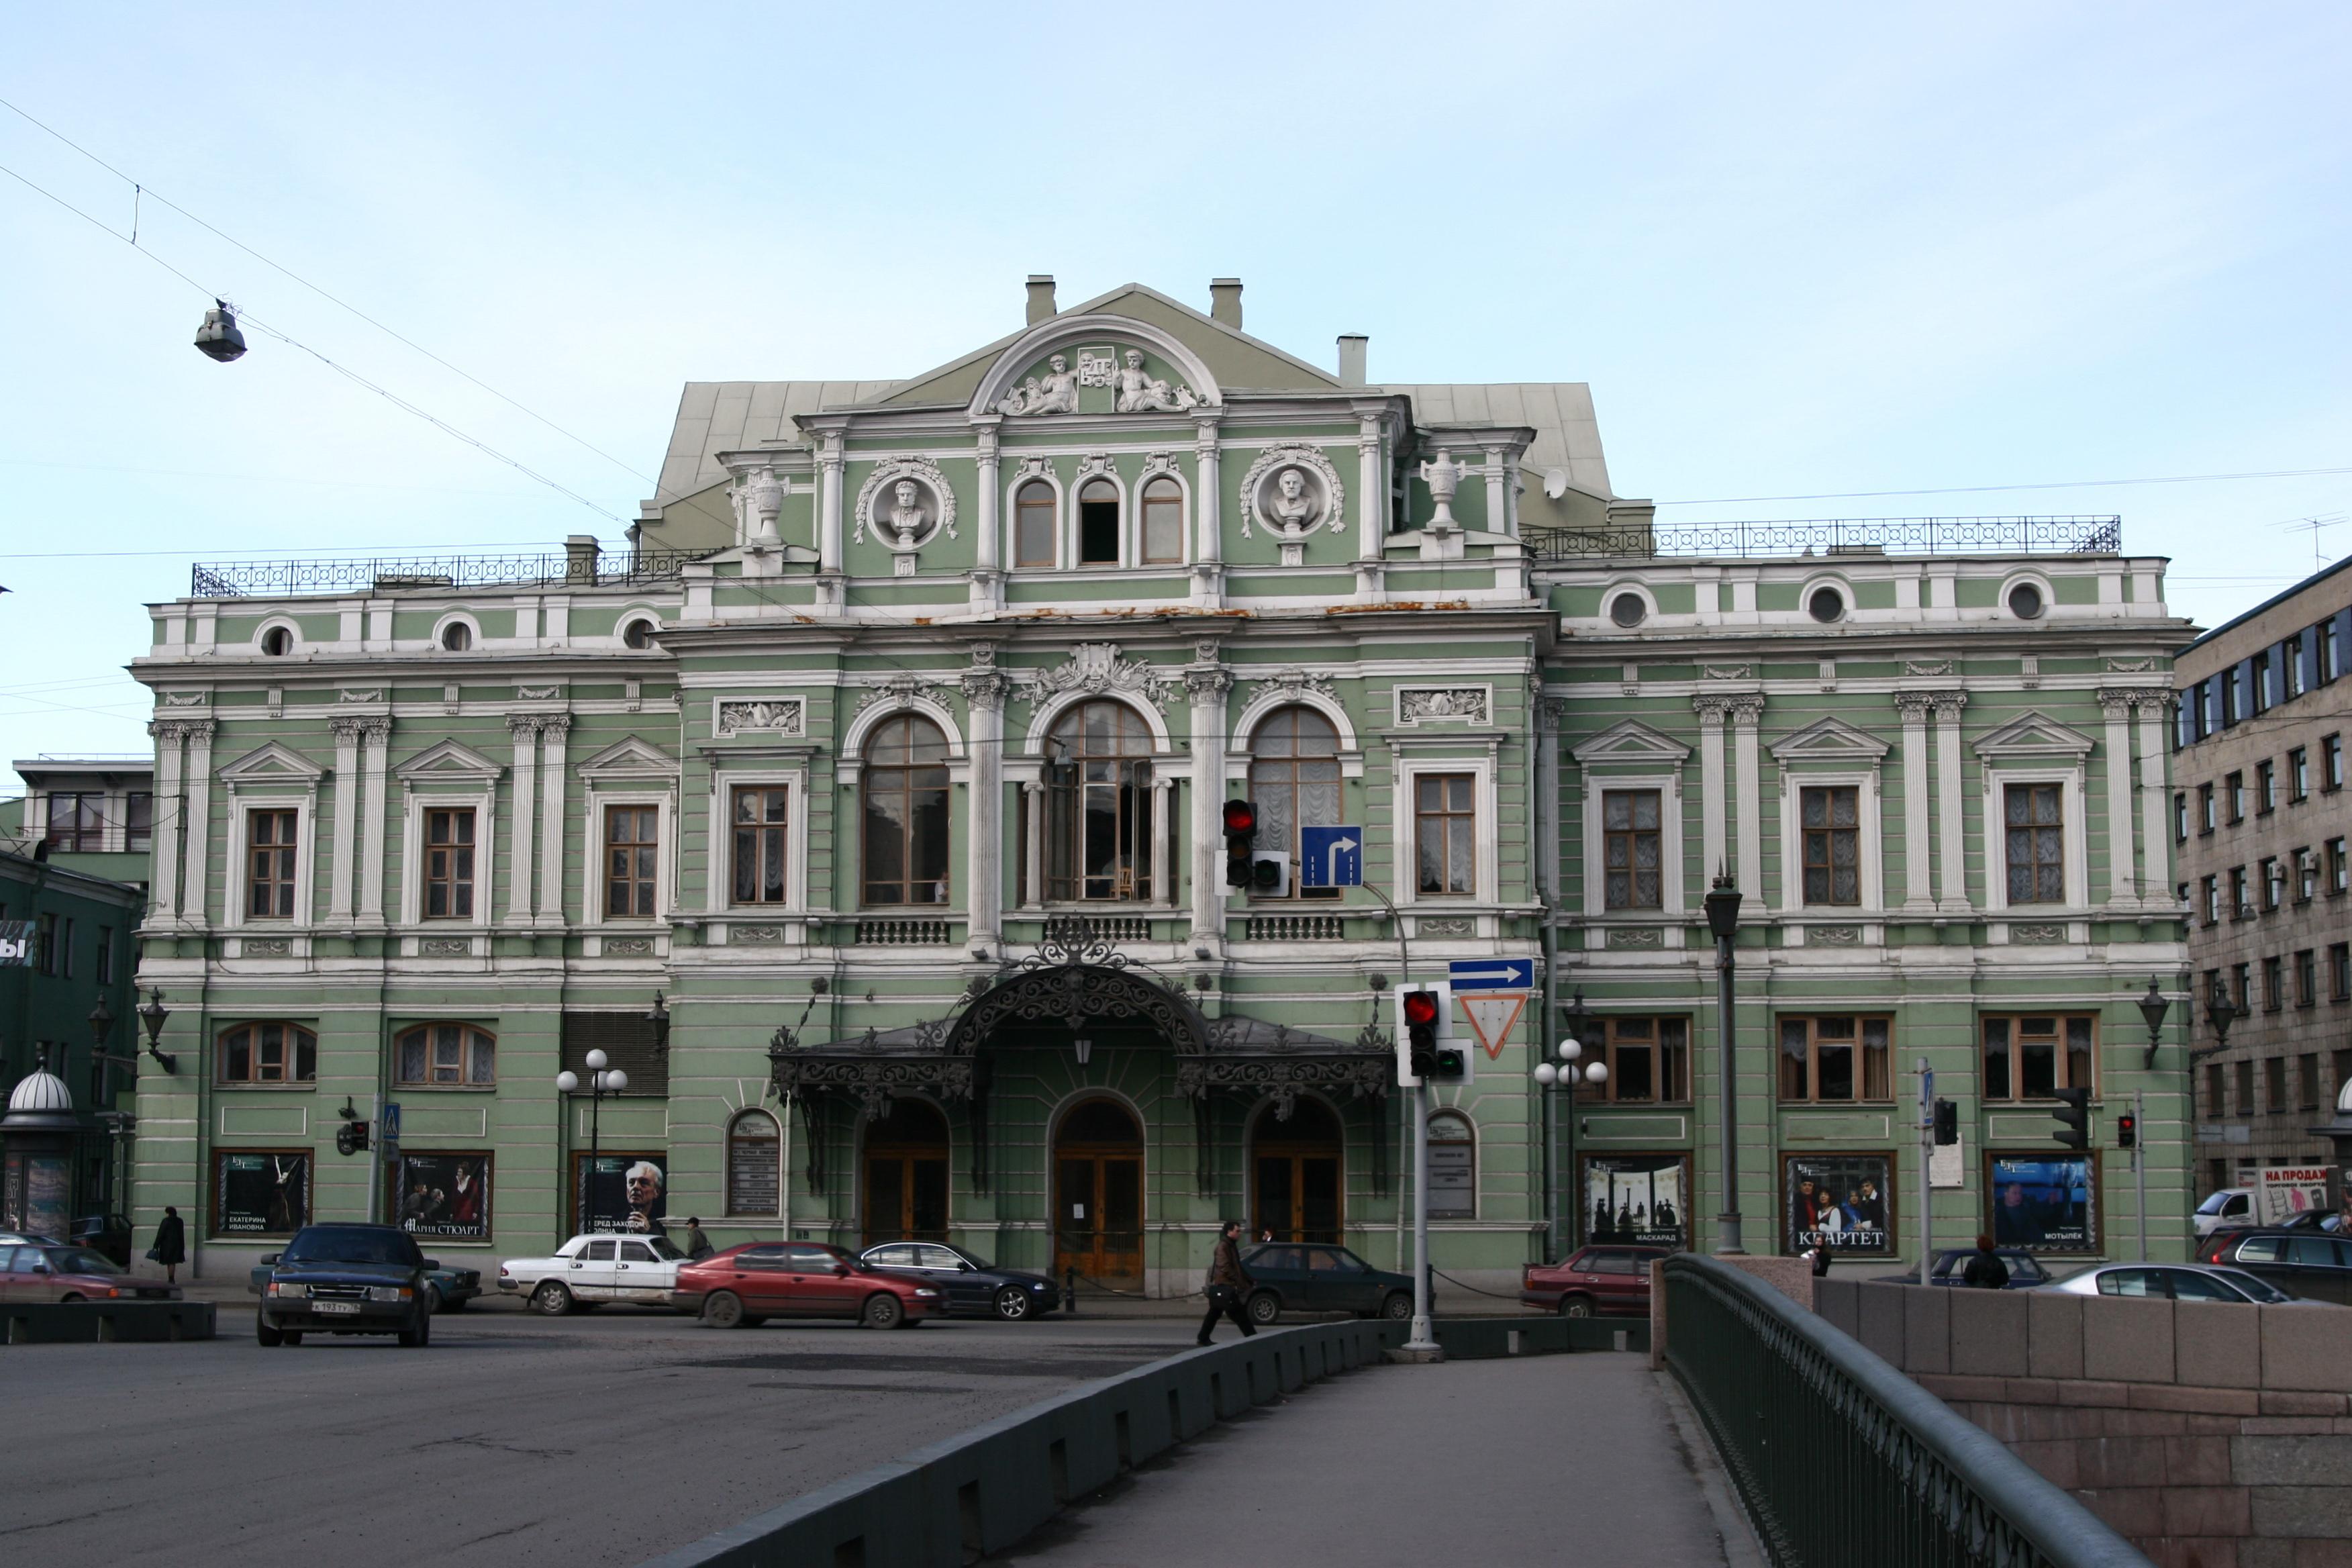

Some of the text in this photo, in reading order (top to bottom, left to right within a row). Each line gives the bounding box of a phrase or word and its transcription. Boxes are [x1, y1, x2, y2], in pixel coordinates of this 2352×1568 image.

[2266, 1171, 2280, 1181] НА
[589, 1220, 645, 1228] ЕРЕД ЗАХОДОМ
